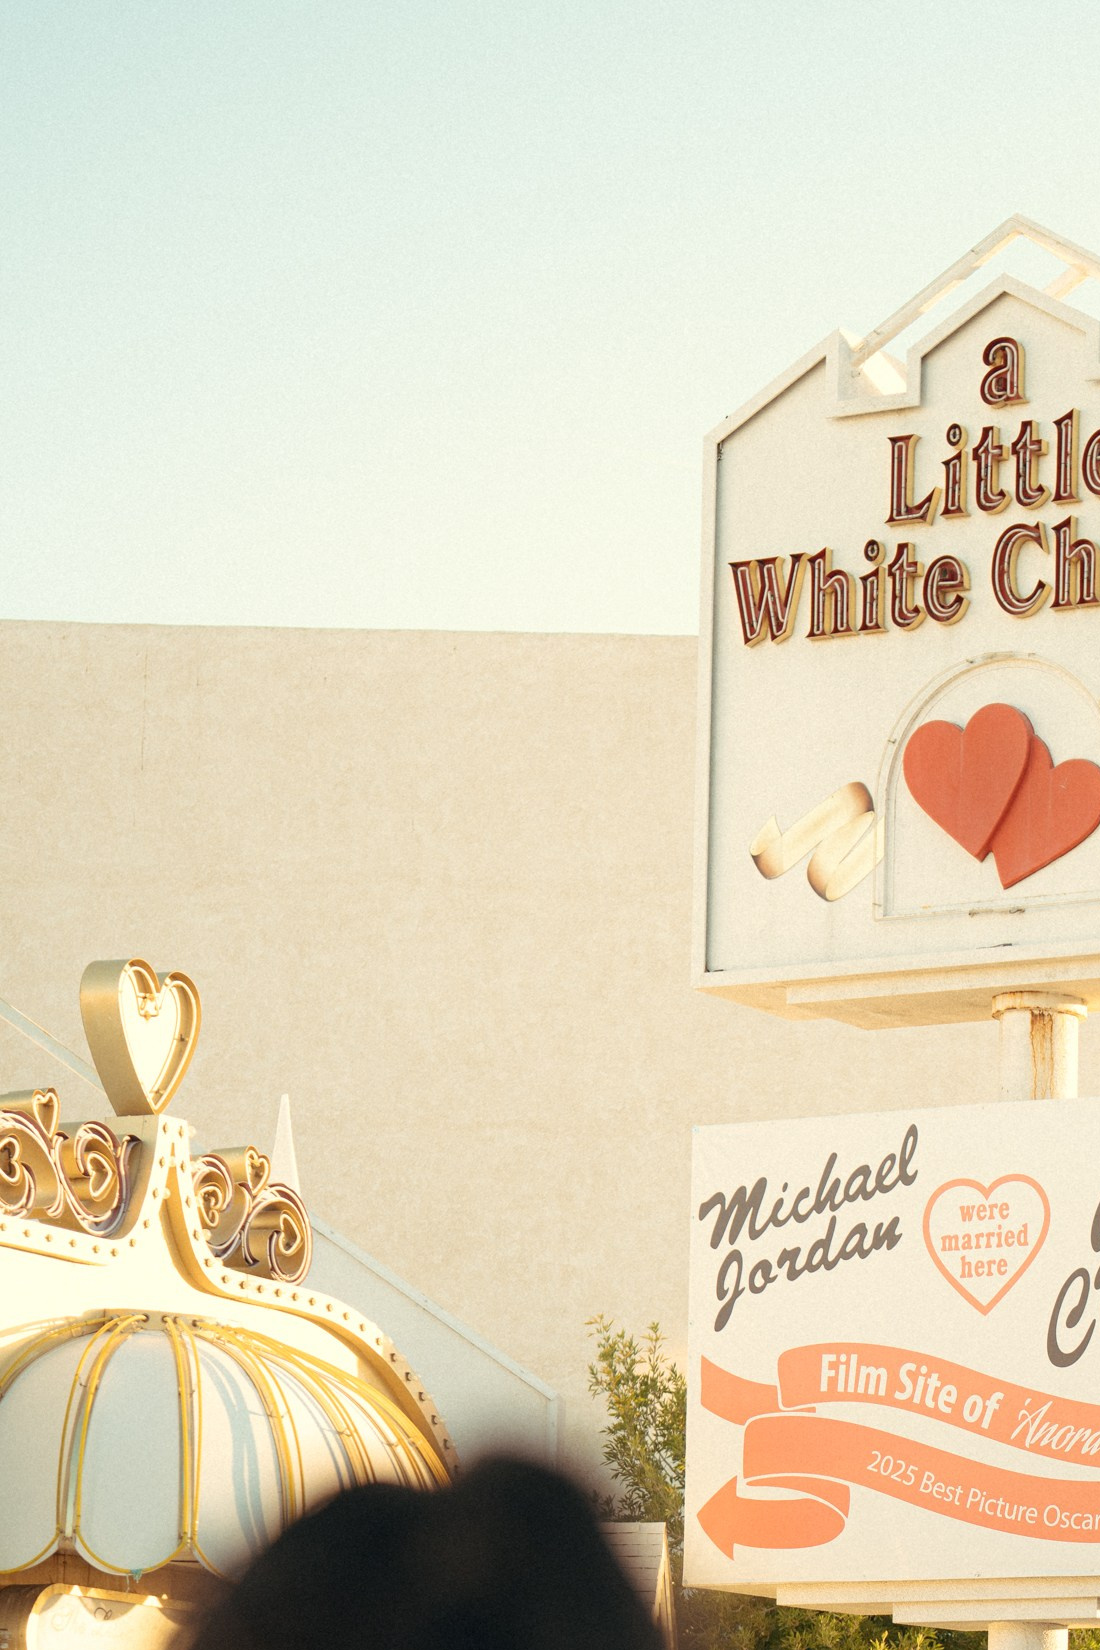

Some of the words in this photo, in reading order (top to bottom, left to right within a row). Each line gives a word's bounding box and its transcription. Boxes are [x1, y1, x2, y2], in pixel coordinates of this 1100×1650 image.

[980, 337, 1030, 407] a
[729, 539, 970, 647] White
[699, 1123, 918, 1250] Michael
[959, 1202, 1010, 1223] were
[714, 1216, 903, 1332] Jordan
[941, 1224, 1029, 1252] married
[960, 1256, 1008, 1279] here
[820, 1354, 888, 1396] Film
[894, 1362, 958, 1413] Site
[963, 1392, 1005, 1430] of
[867, 1451, 916, 1486] 2025
[920, 1472, 963, 1505] Best
[967, 1488, 1038, 1524] Picture
